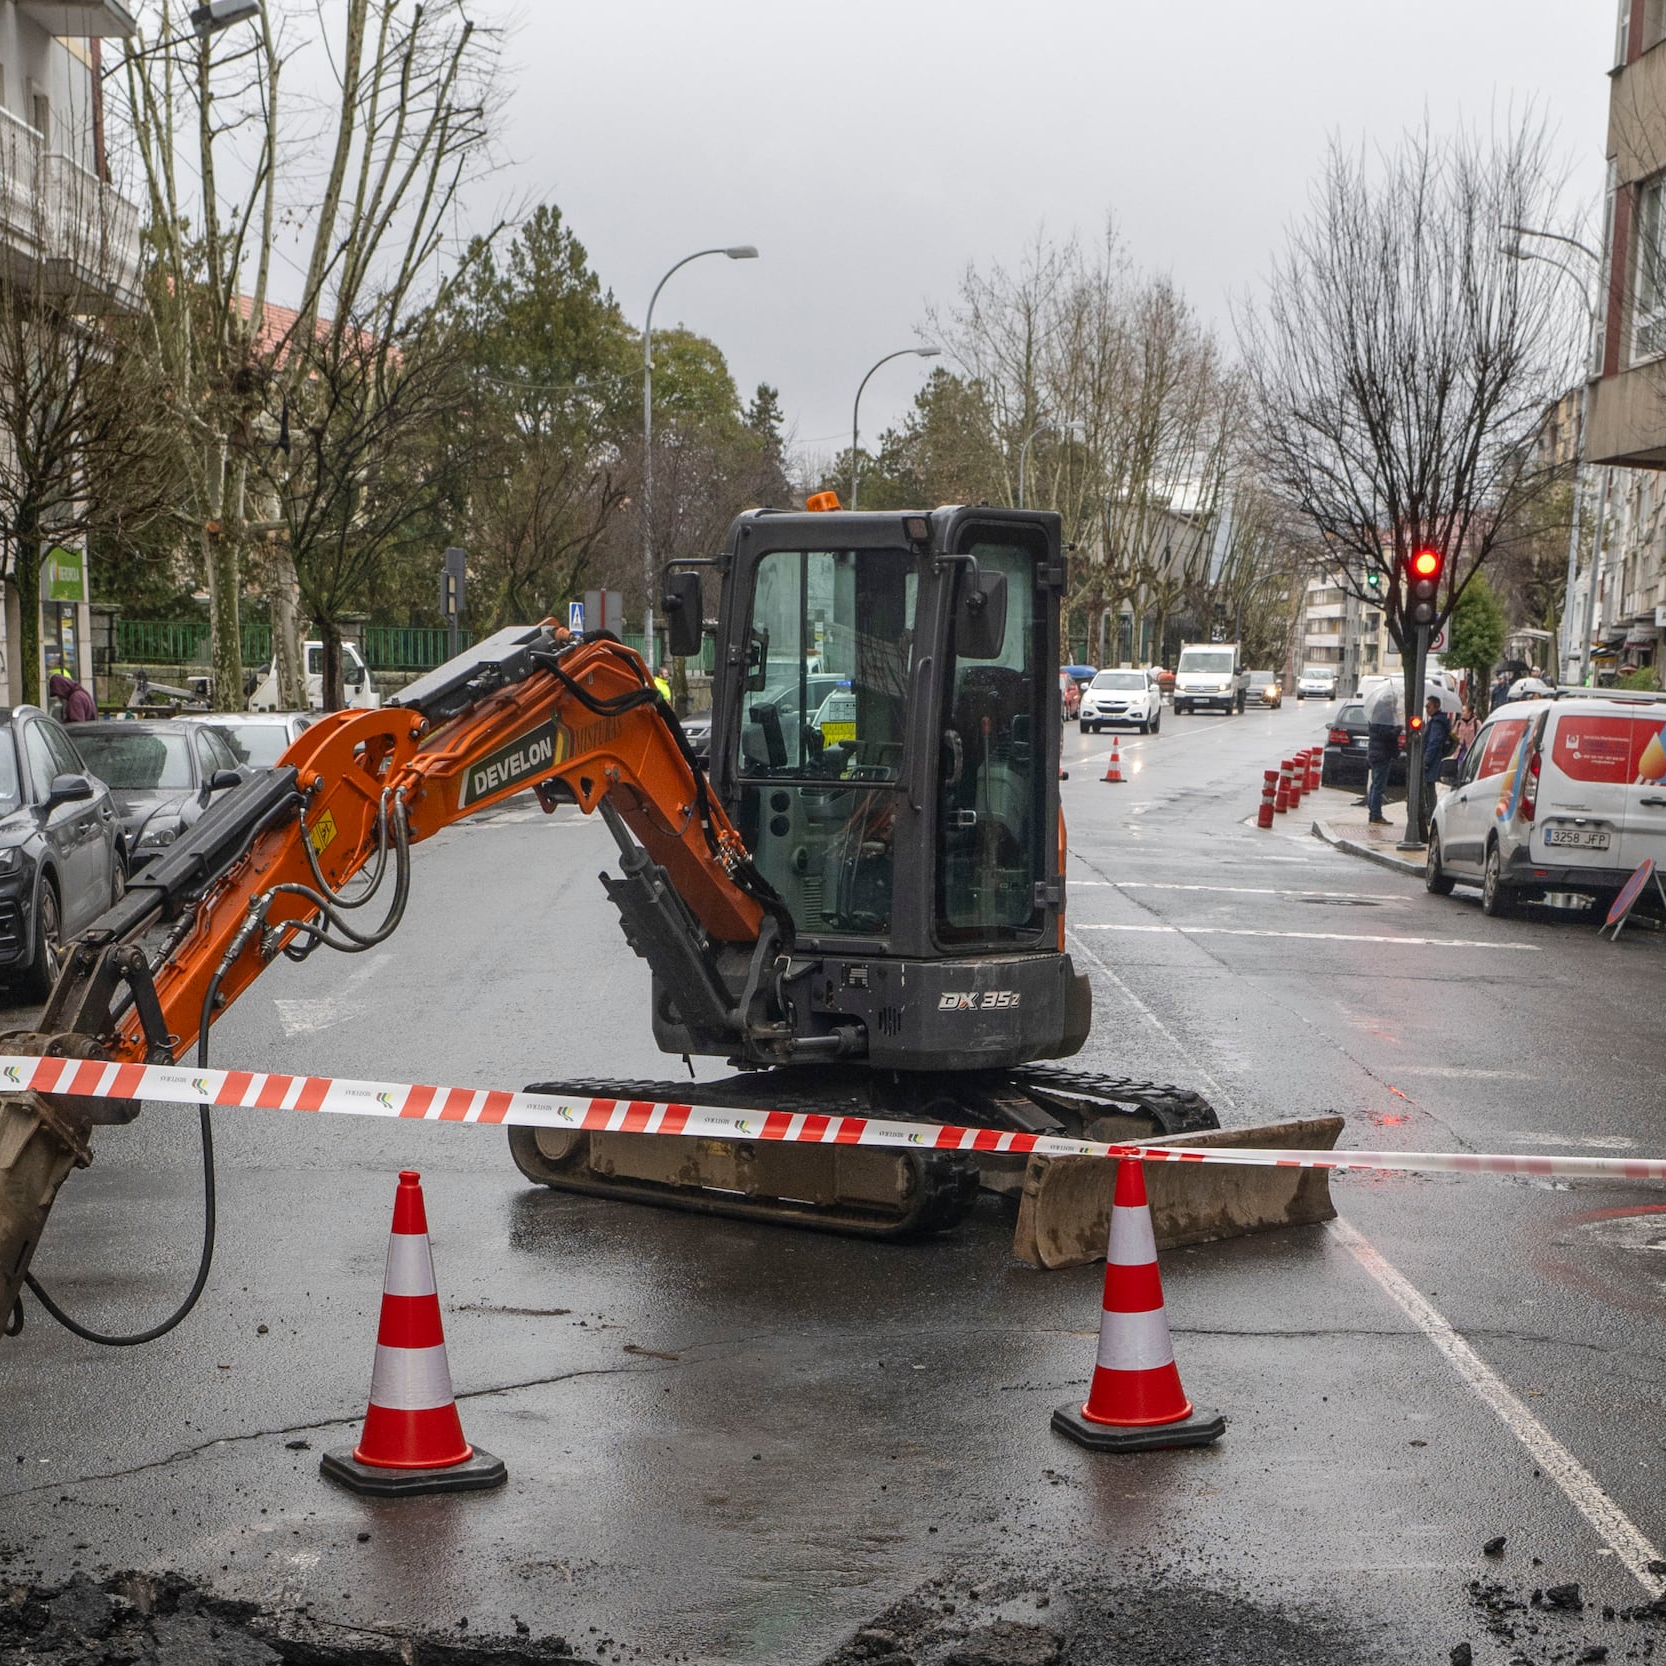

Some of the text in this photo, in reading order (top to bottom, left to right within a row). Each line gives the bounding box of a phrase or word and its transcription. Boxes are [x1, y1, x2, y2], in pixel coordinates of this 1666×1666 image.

[473, 736, 553, 797] DEVELON
[1553, 831, 1606, 845] 3258 JFP
[938, 991, 979, 1011] DX
